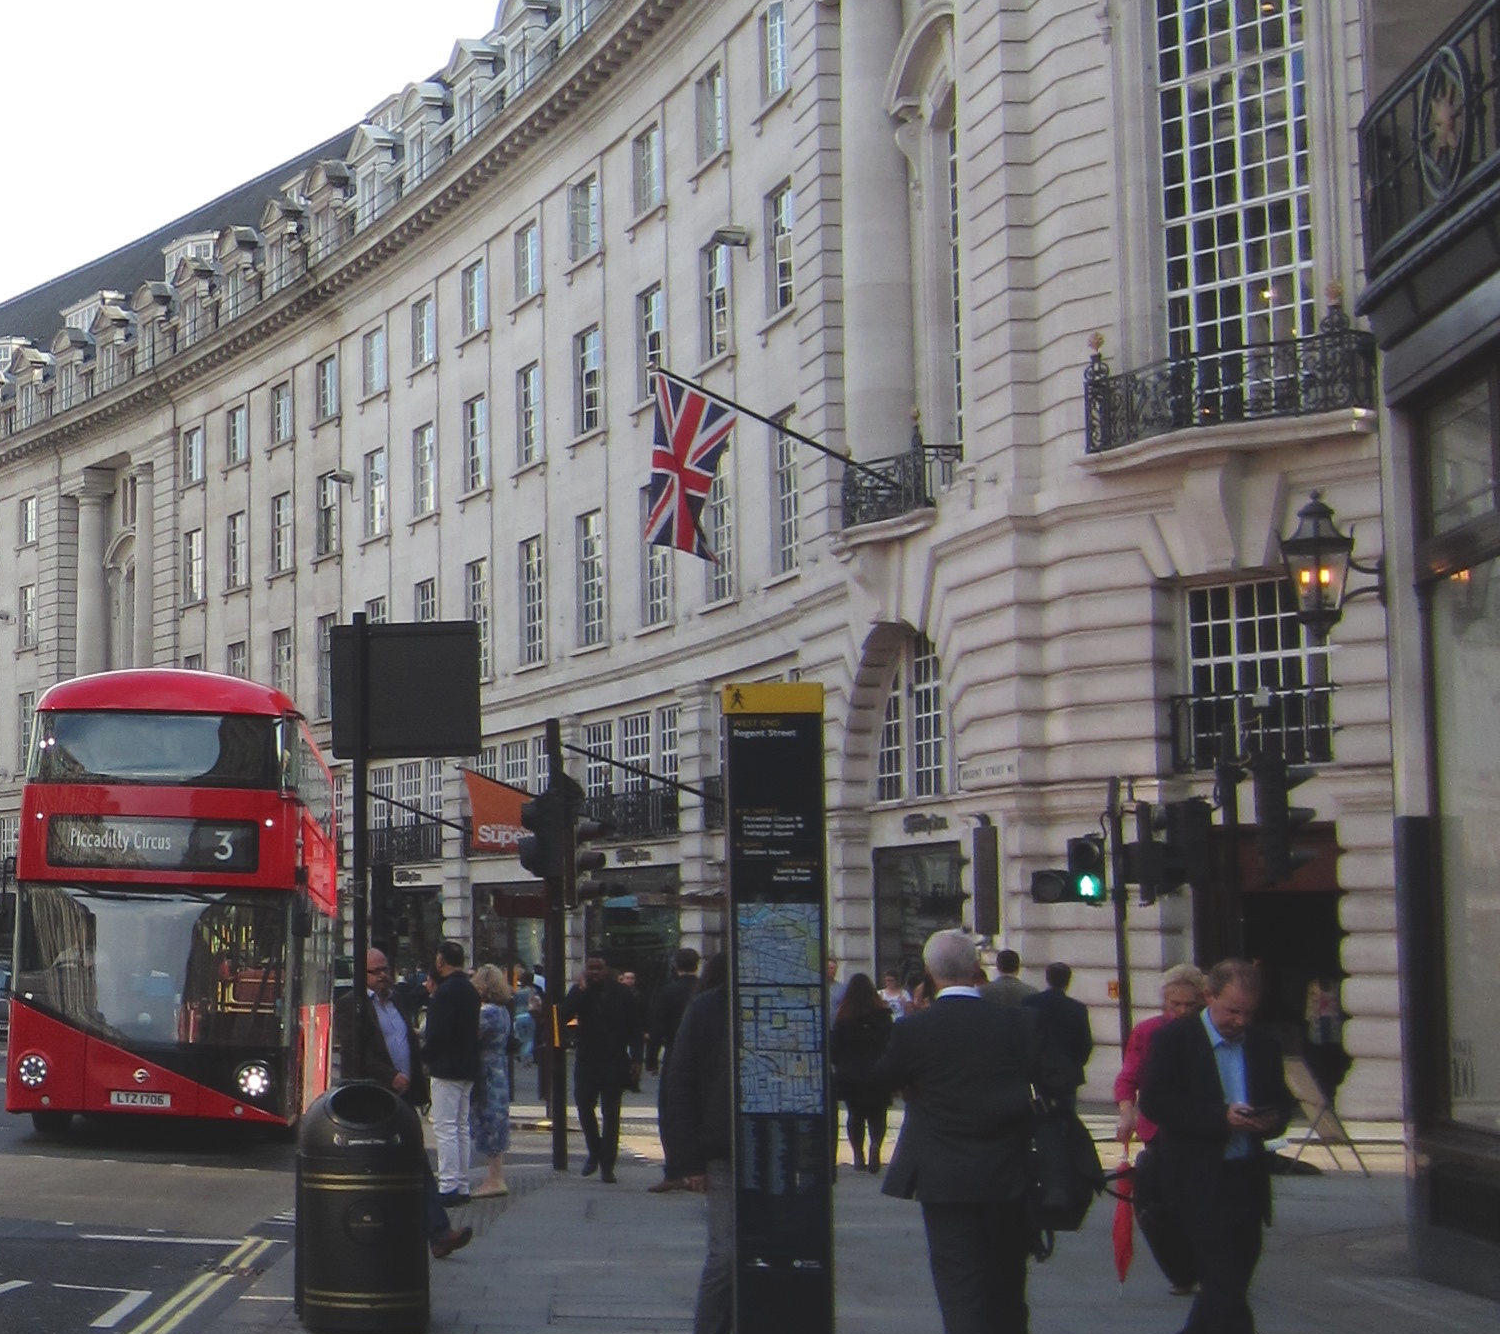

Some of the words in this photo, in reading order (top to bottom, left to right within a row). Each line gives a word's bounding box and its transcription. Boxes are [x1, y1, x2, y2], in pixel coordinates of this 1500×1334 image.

[732, 719, 758, 728] WEST
[760, 719, 781, 728] END
[733, 728, 766, 739] Regent
[767, 728, 797, 738] Street
[962, 767, 982, 781] REGENT
[984, 765, 1006, 778] STREET
[742, 815, 772, 823] Piccadilly
[743, 830, 772, 838] Trafalgar
[70, 827, 130, 855] Piccadilly
[133, 830, 172, 851] Circus
[213, 830, 234, 861] 3
[116, 1093, 138, 1104] LTZ
[140, 1094, 165, 1105] 1706
